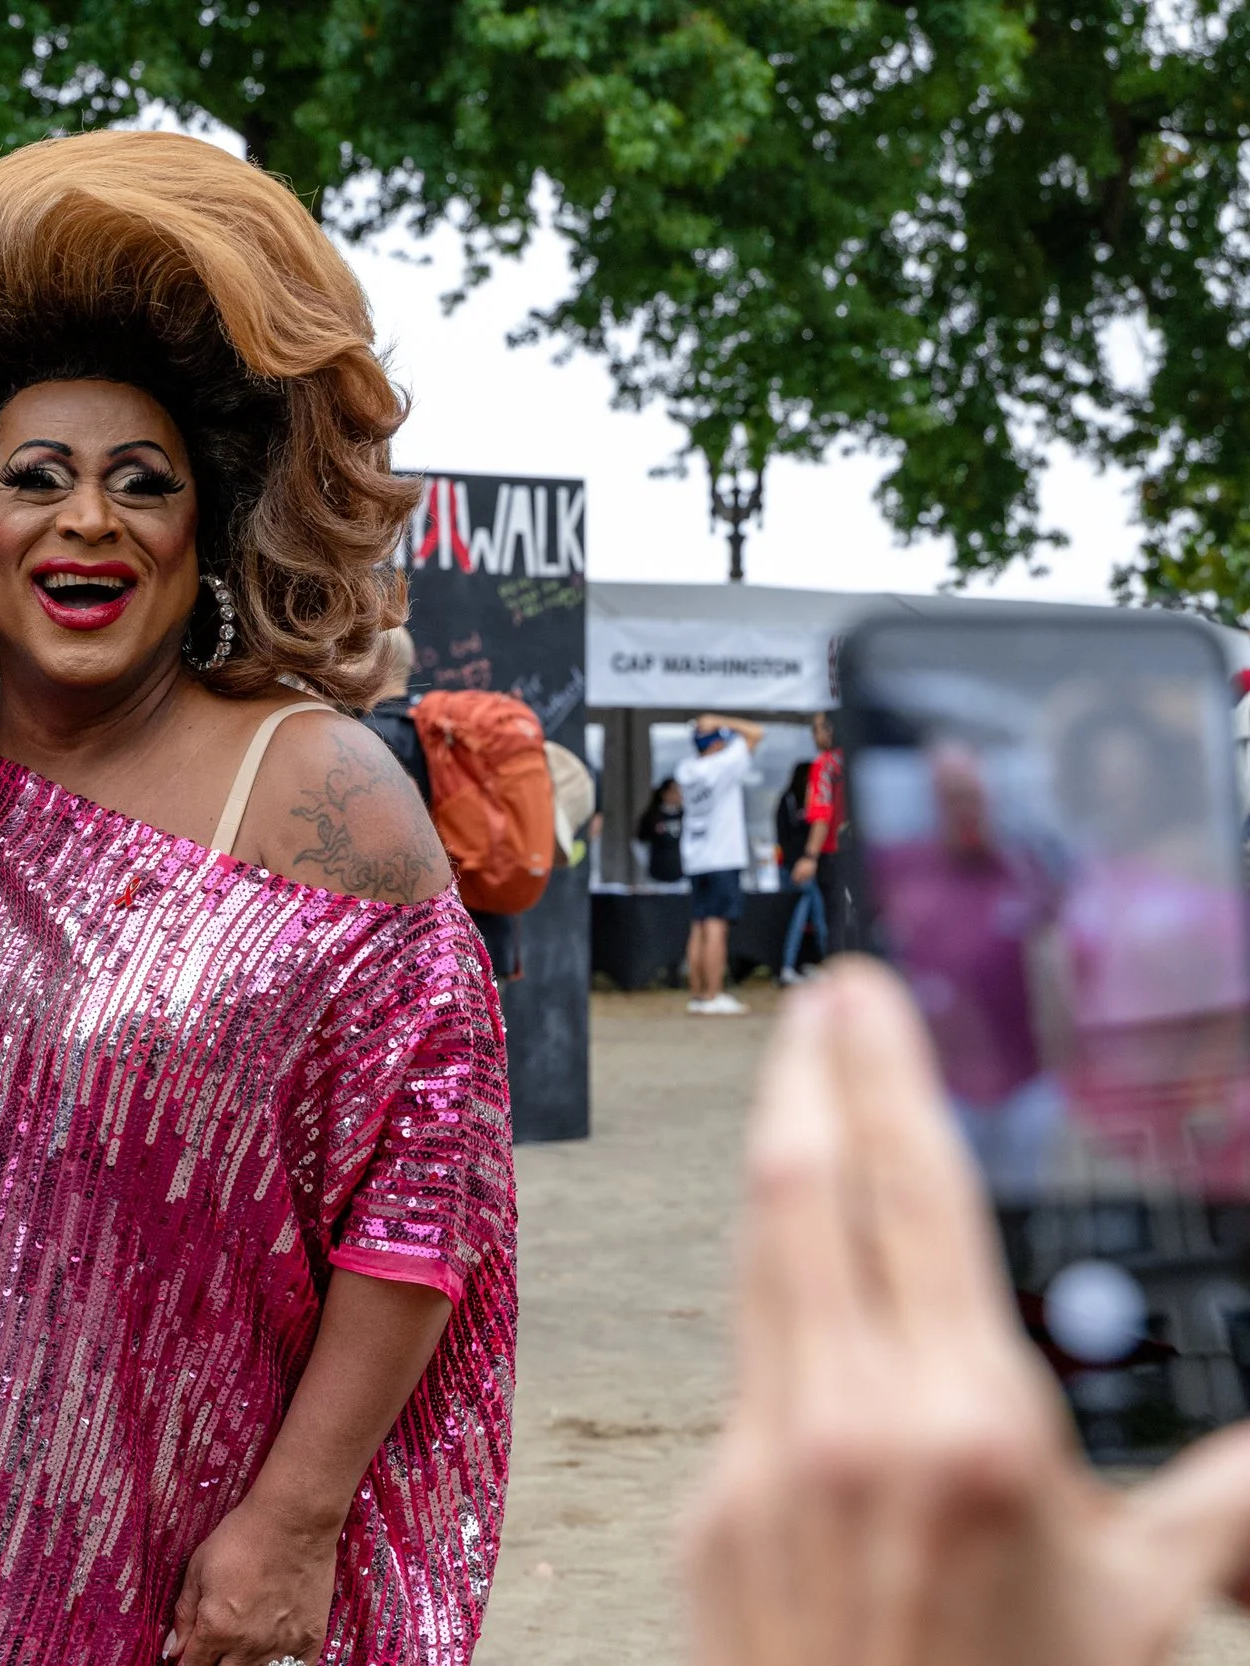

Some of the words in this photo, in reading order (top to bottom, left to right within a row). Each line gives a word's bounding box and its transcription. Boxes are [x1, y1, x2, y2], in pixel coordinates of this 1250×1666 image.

[454, 480, 585, 580] WALK
[610, 651, 654, 675] CAP
[660, 653, 803, 679] WASHINGTON
